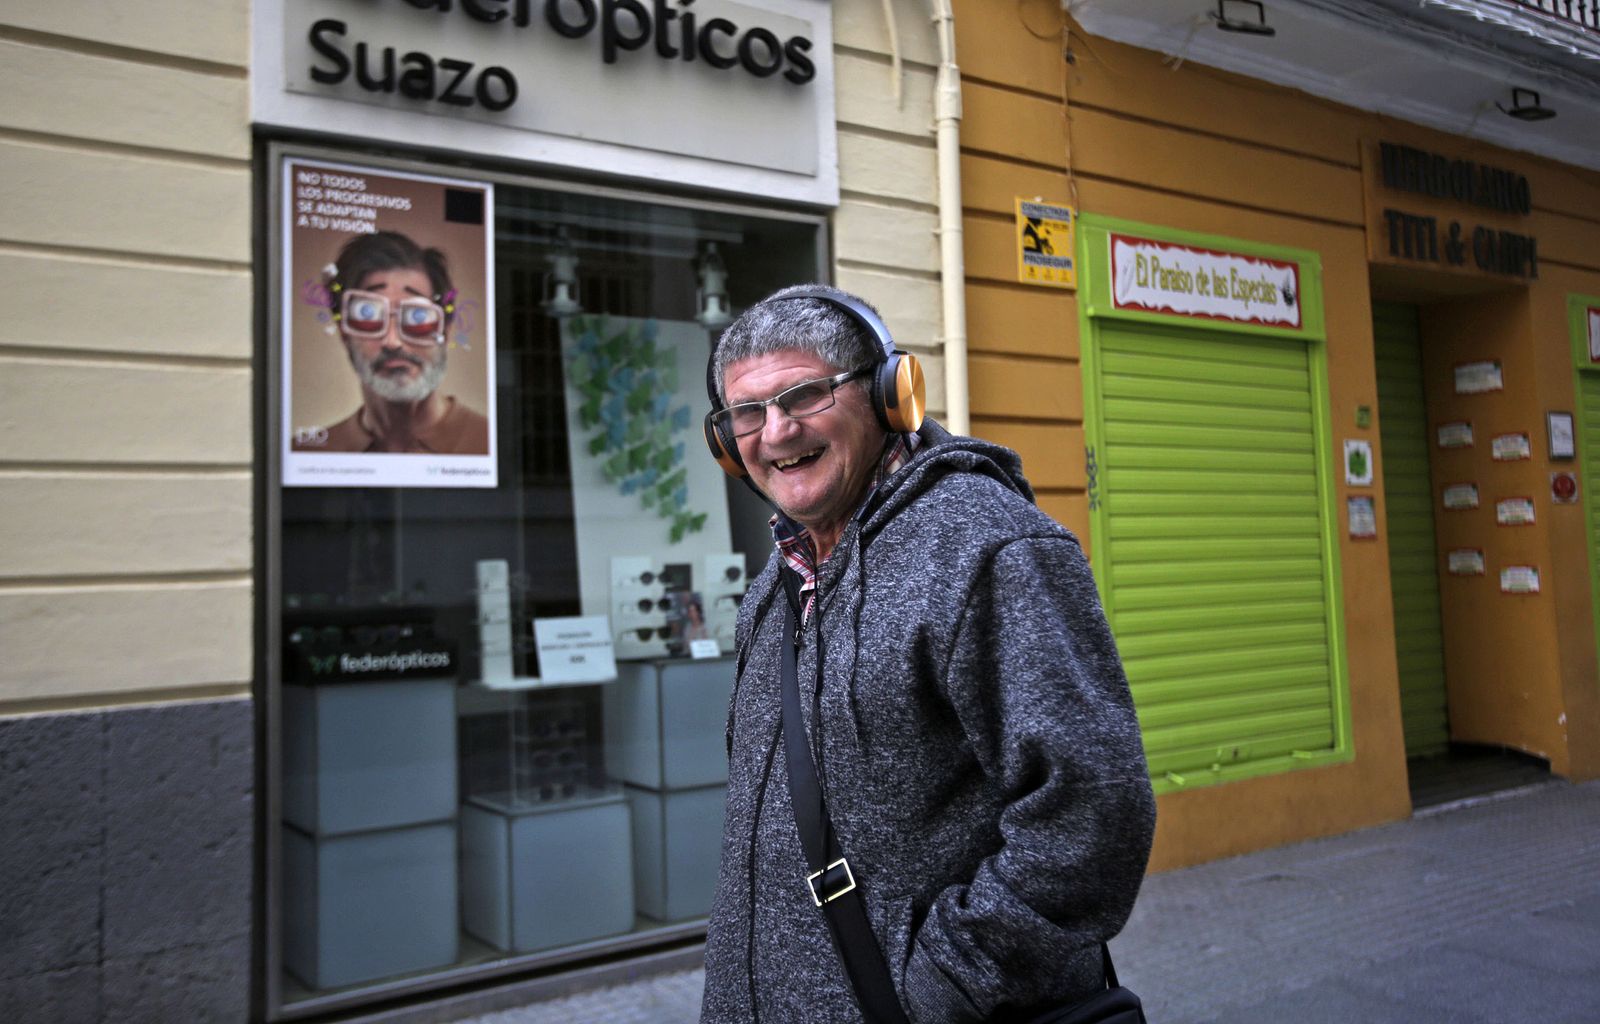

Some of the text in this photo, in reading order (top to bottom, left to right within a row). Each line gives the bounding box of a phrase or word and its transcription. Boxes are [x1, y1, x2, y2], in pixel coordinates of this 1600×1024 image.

[308, 18, 518, 112] Suazo
[297, 171, 367, 191] NO TODOS
[297, 185, 412, 211] LOS PROGRESIVOS
[297, 200, 377, 220] SE ADAPTAN
[297, 215, 309, 227] A
[311, 216, 329, 229] TU
[1023, 253, 1072, 269] PROSEGUR
[1135, 252, 1148, 288] El
[1195, 266, 1211, 298] de
[1212, 269, 1229, 300] las
[1230, 268, 1278, 309] Especias
[340, 648, 451, 674] federópticos
